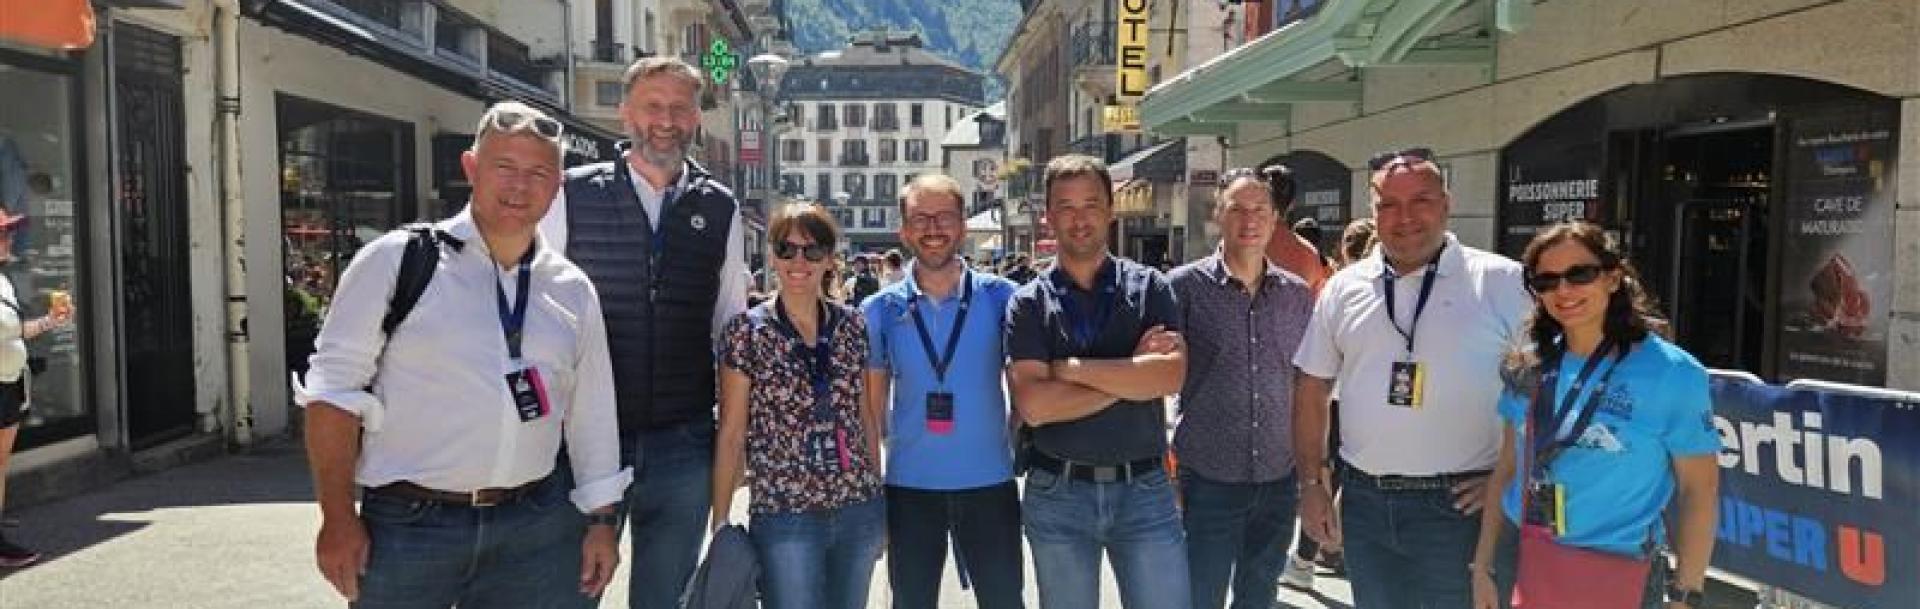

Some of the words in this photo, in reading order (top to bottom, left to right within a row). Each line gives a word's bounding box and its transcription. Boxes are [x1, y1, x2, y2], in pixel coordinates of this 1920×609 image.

[1509, 180, 1598, 202] POISSONNERIE
[1543, 201, 1585, 220] SUPER
[1713, 411, 1883, 499] ertin
[1838, 524, 1885, 585] U
